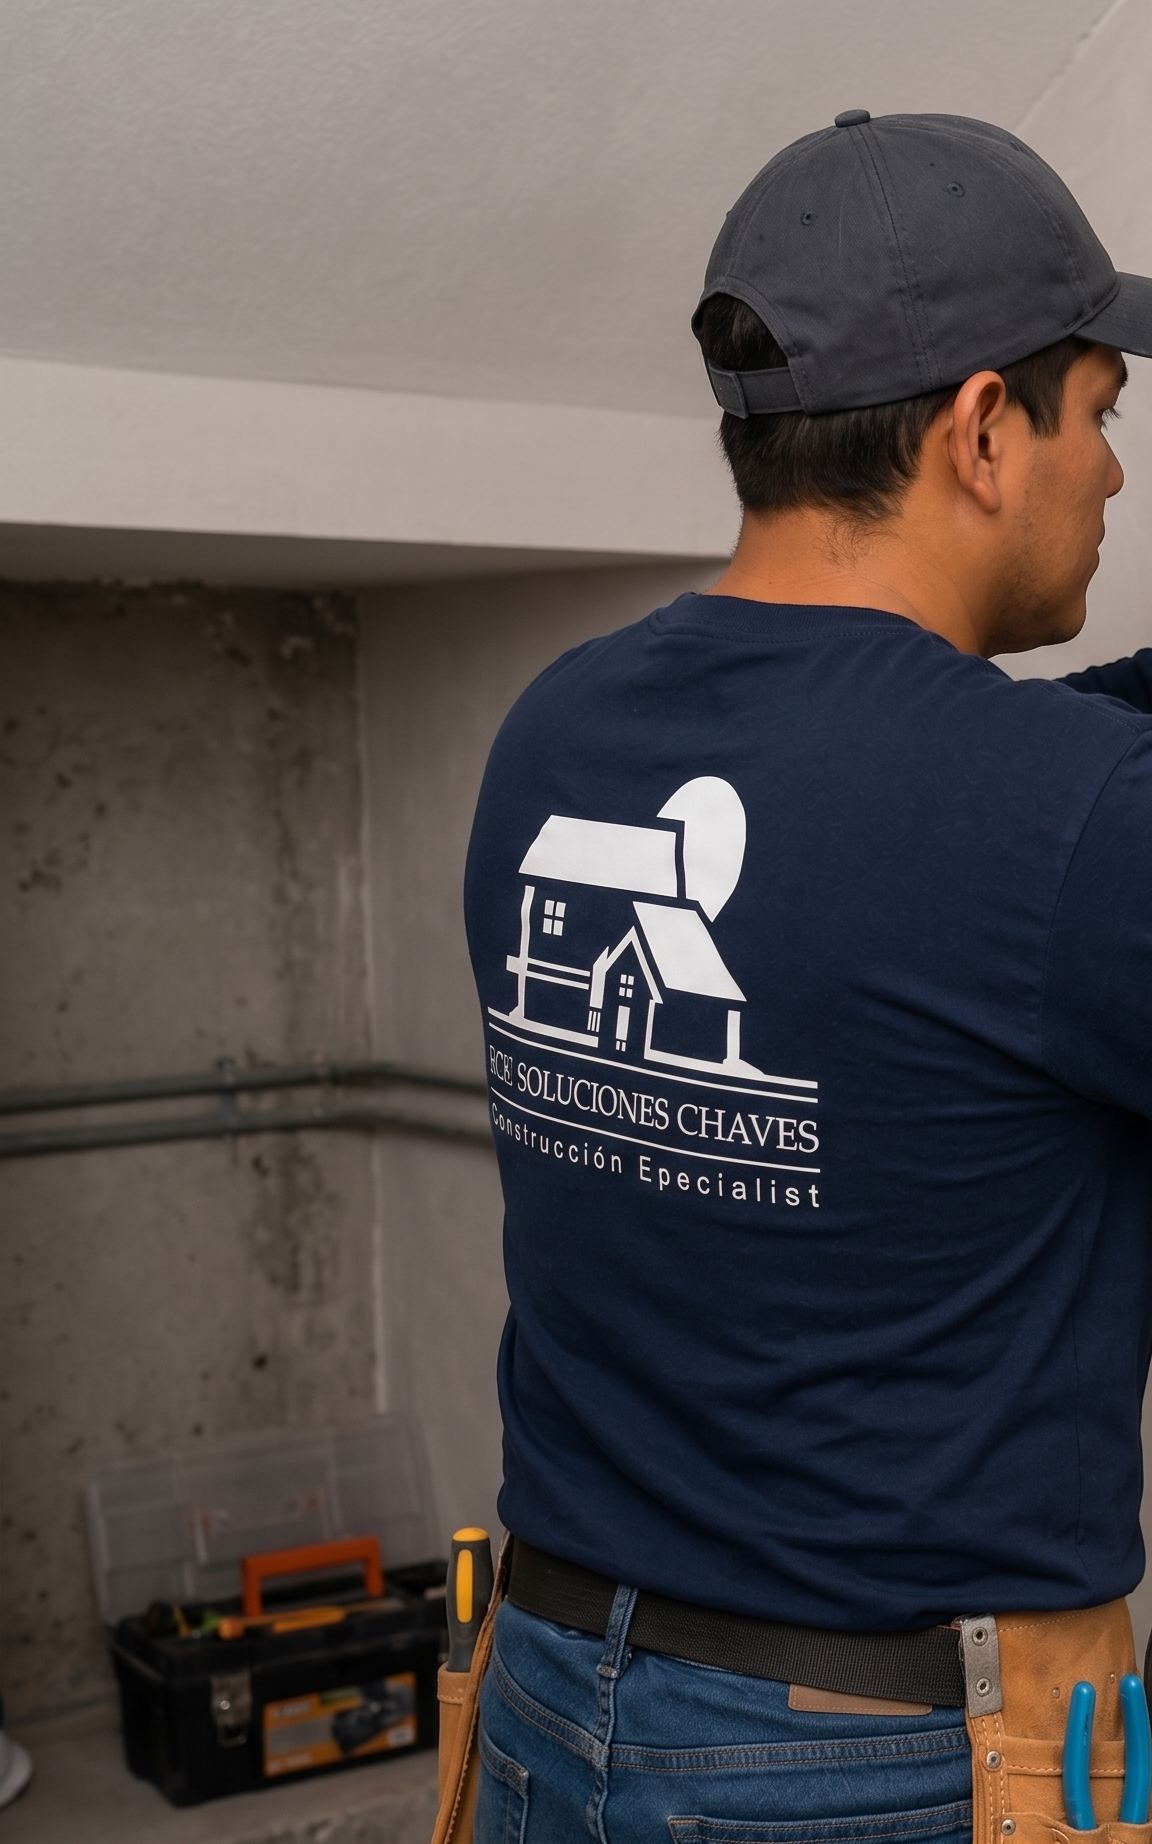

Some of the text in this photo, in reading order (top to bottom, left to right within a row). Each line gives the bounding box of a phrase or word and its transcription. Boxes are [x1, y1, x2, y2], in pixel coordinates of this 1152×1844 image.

[492, 1102, 821, 1208] Construcción Epecialist
[517, 1062, 670, 1130] SOLUCIONES
[676, 1103, 820, 1154] CHAVES
